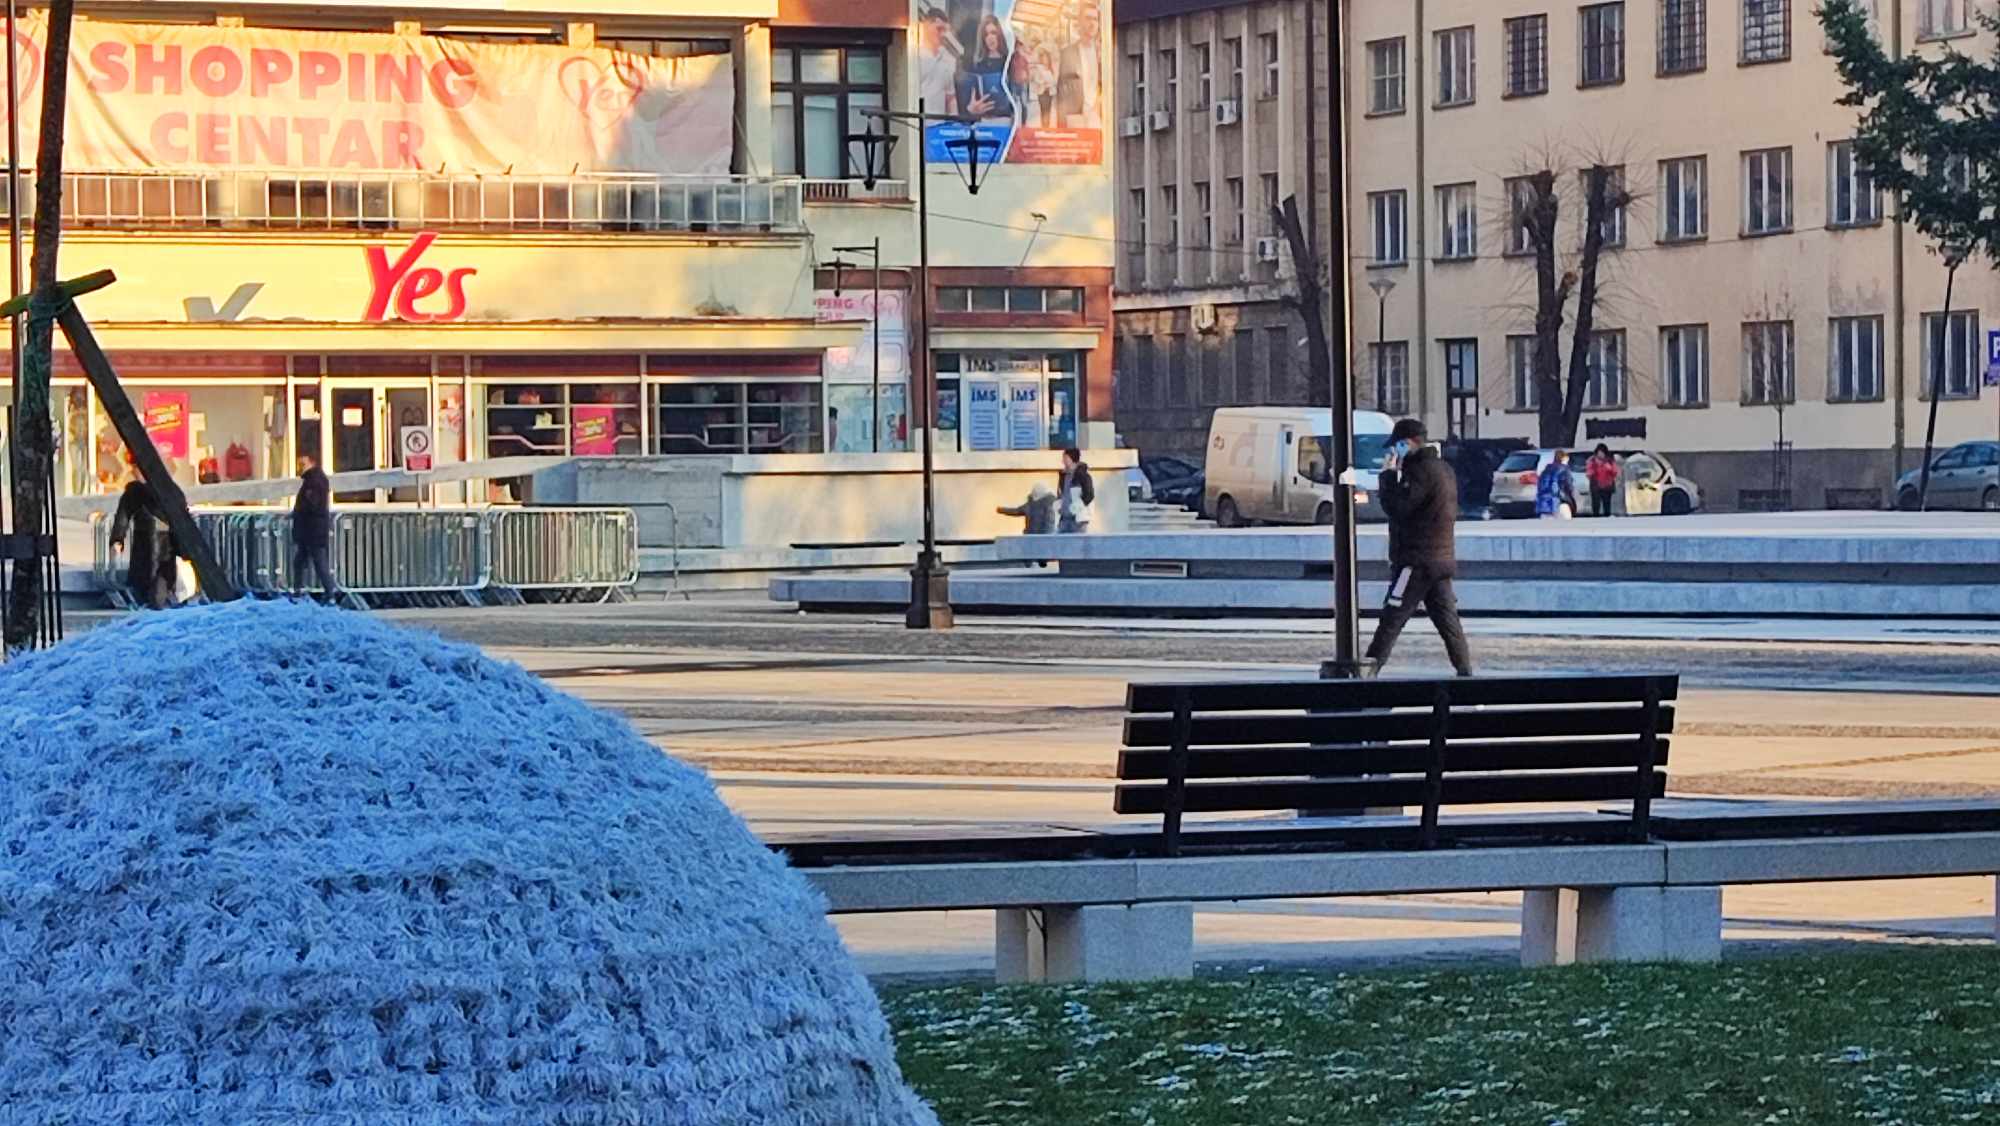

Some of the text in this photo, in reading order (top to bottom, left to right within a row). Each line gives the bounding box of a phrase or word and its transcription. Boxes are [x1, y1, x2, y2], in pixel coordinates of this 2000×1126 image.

[90, 41, 479, 109] SHOPPING
[150, 112, 425, 170] CENTAR
[363, 231, 477, 321] Yes
[966, 357, 995, 372] IMS
[971, 387, 997, 402] IMS
[1011, 386, 1037, 402] IMS
